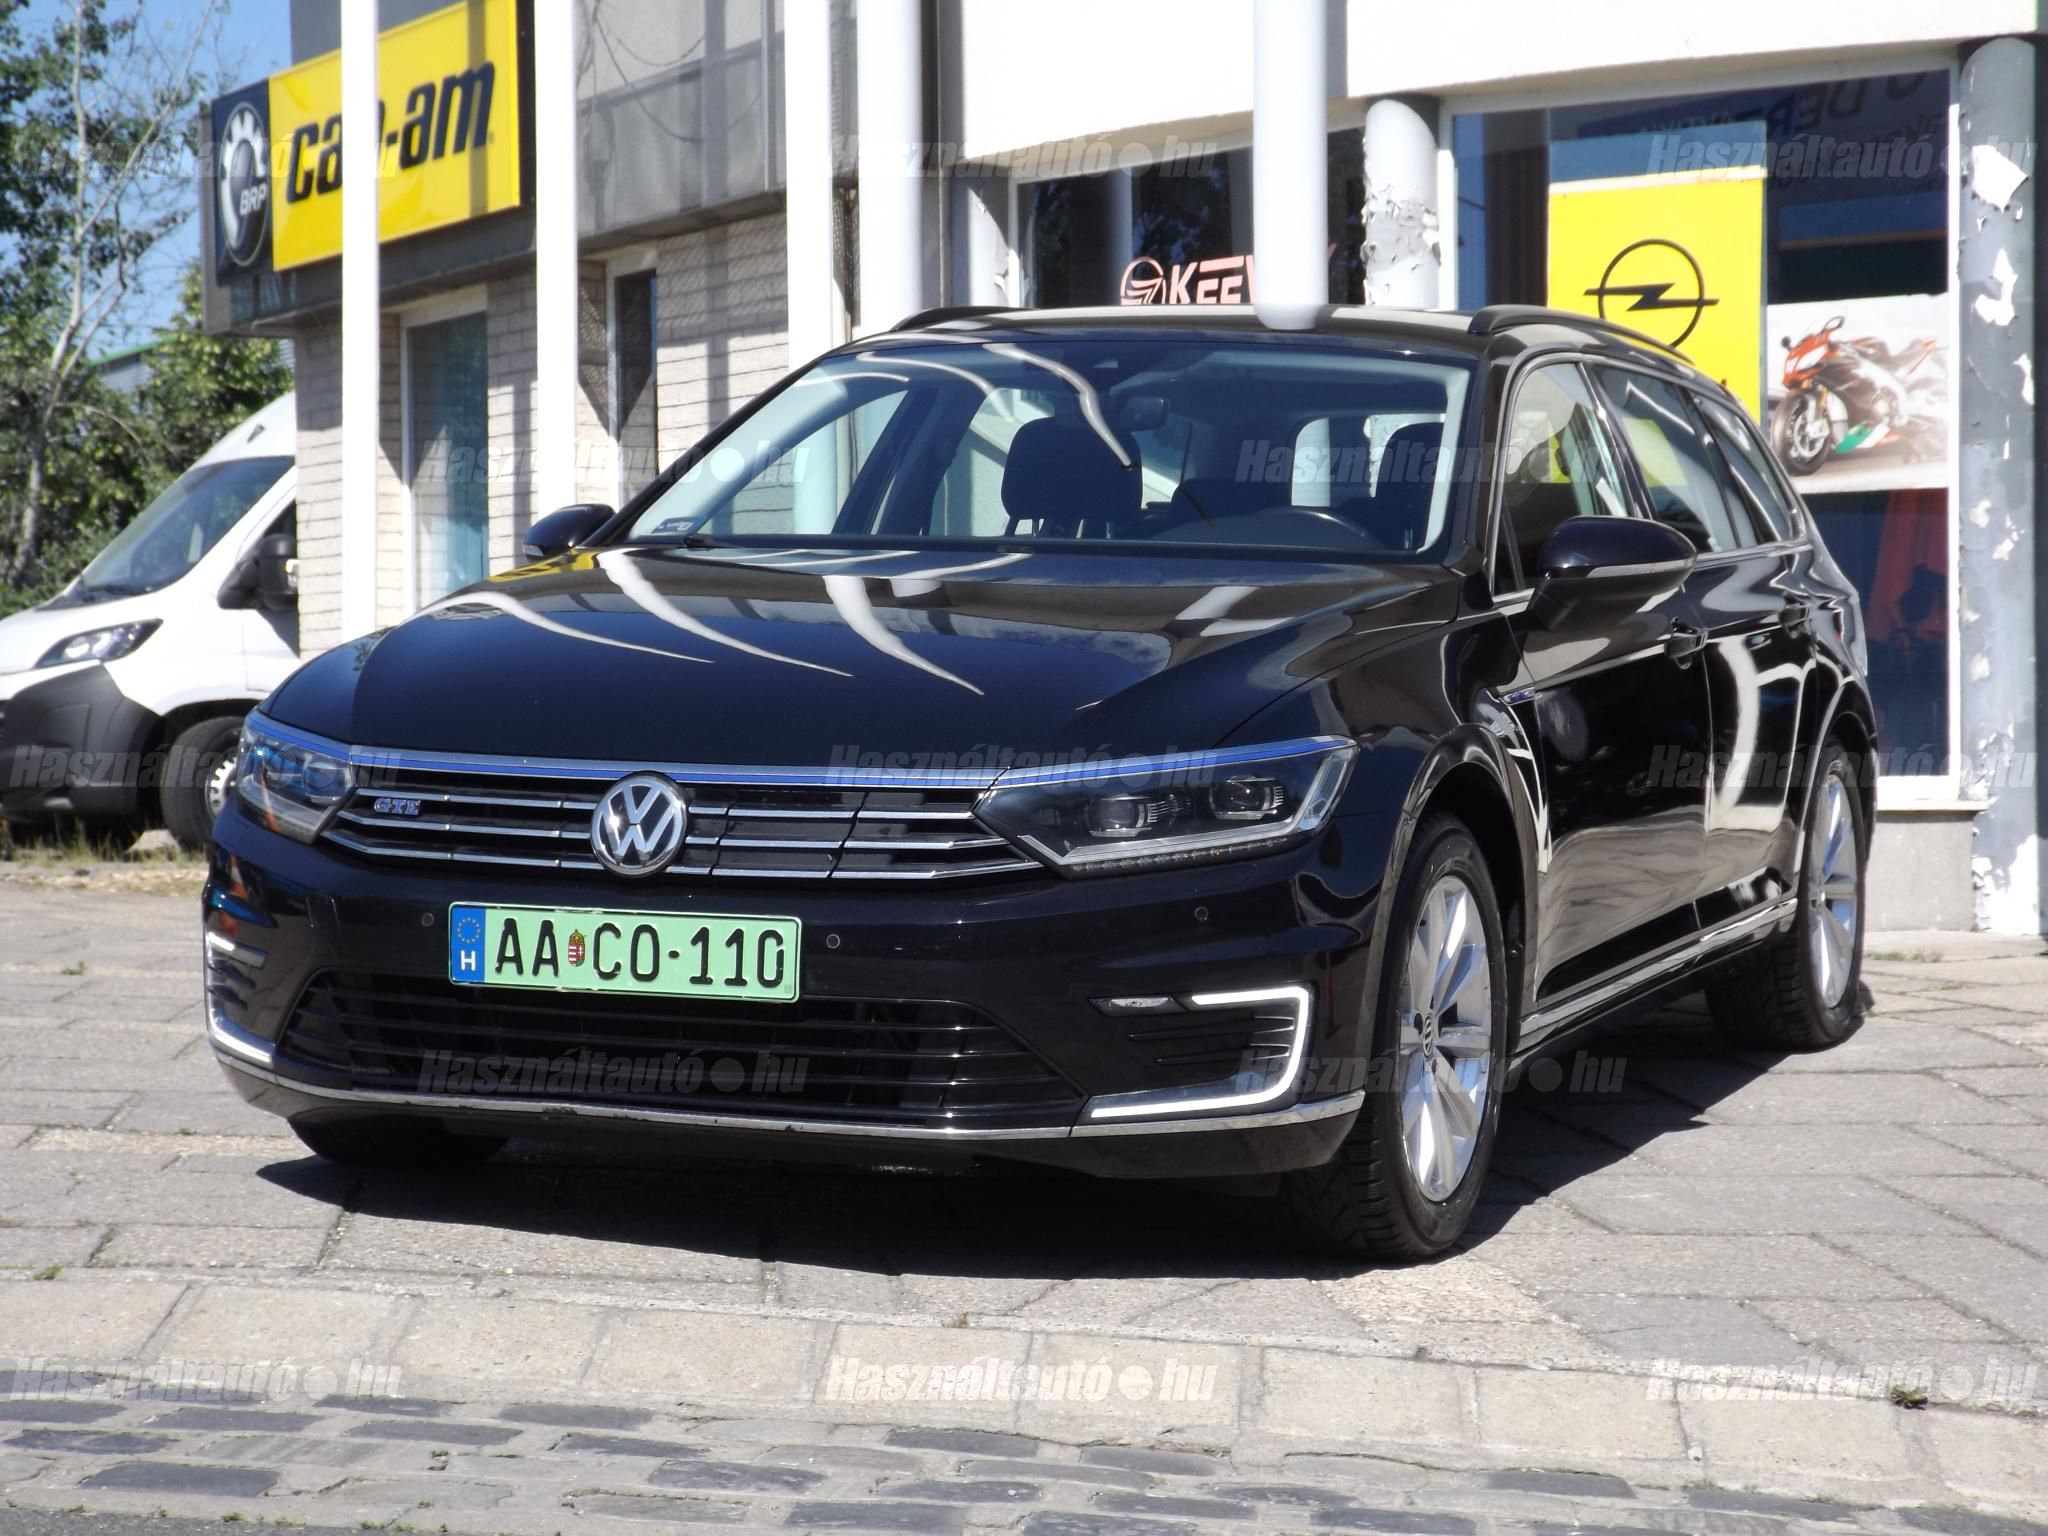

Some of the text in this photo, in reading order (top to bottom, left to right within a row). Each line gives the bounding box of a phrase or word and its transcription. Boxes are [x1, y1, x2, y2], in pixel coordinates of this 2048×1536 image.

[287, 61, 495, 204] ca-am
[239, 184, 267, 215] BRP
[373, 797, 421, 817] GTE
[459, 950, 477, 972] H
